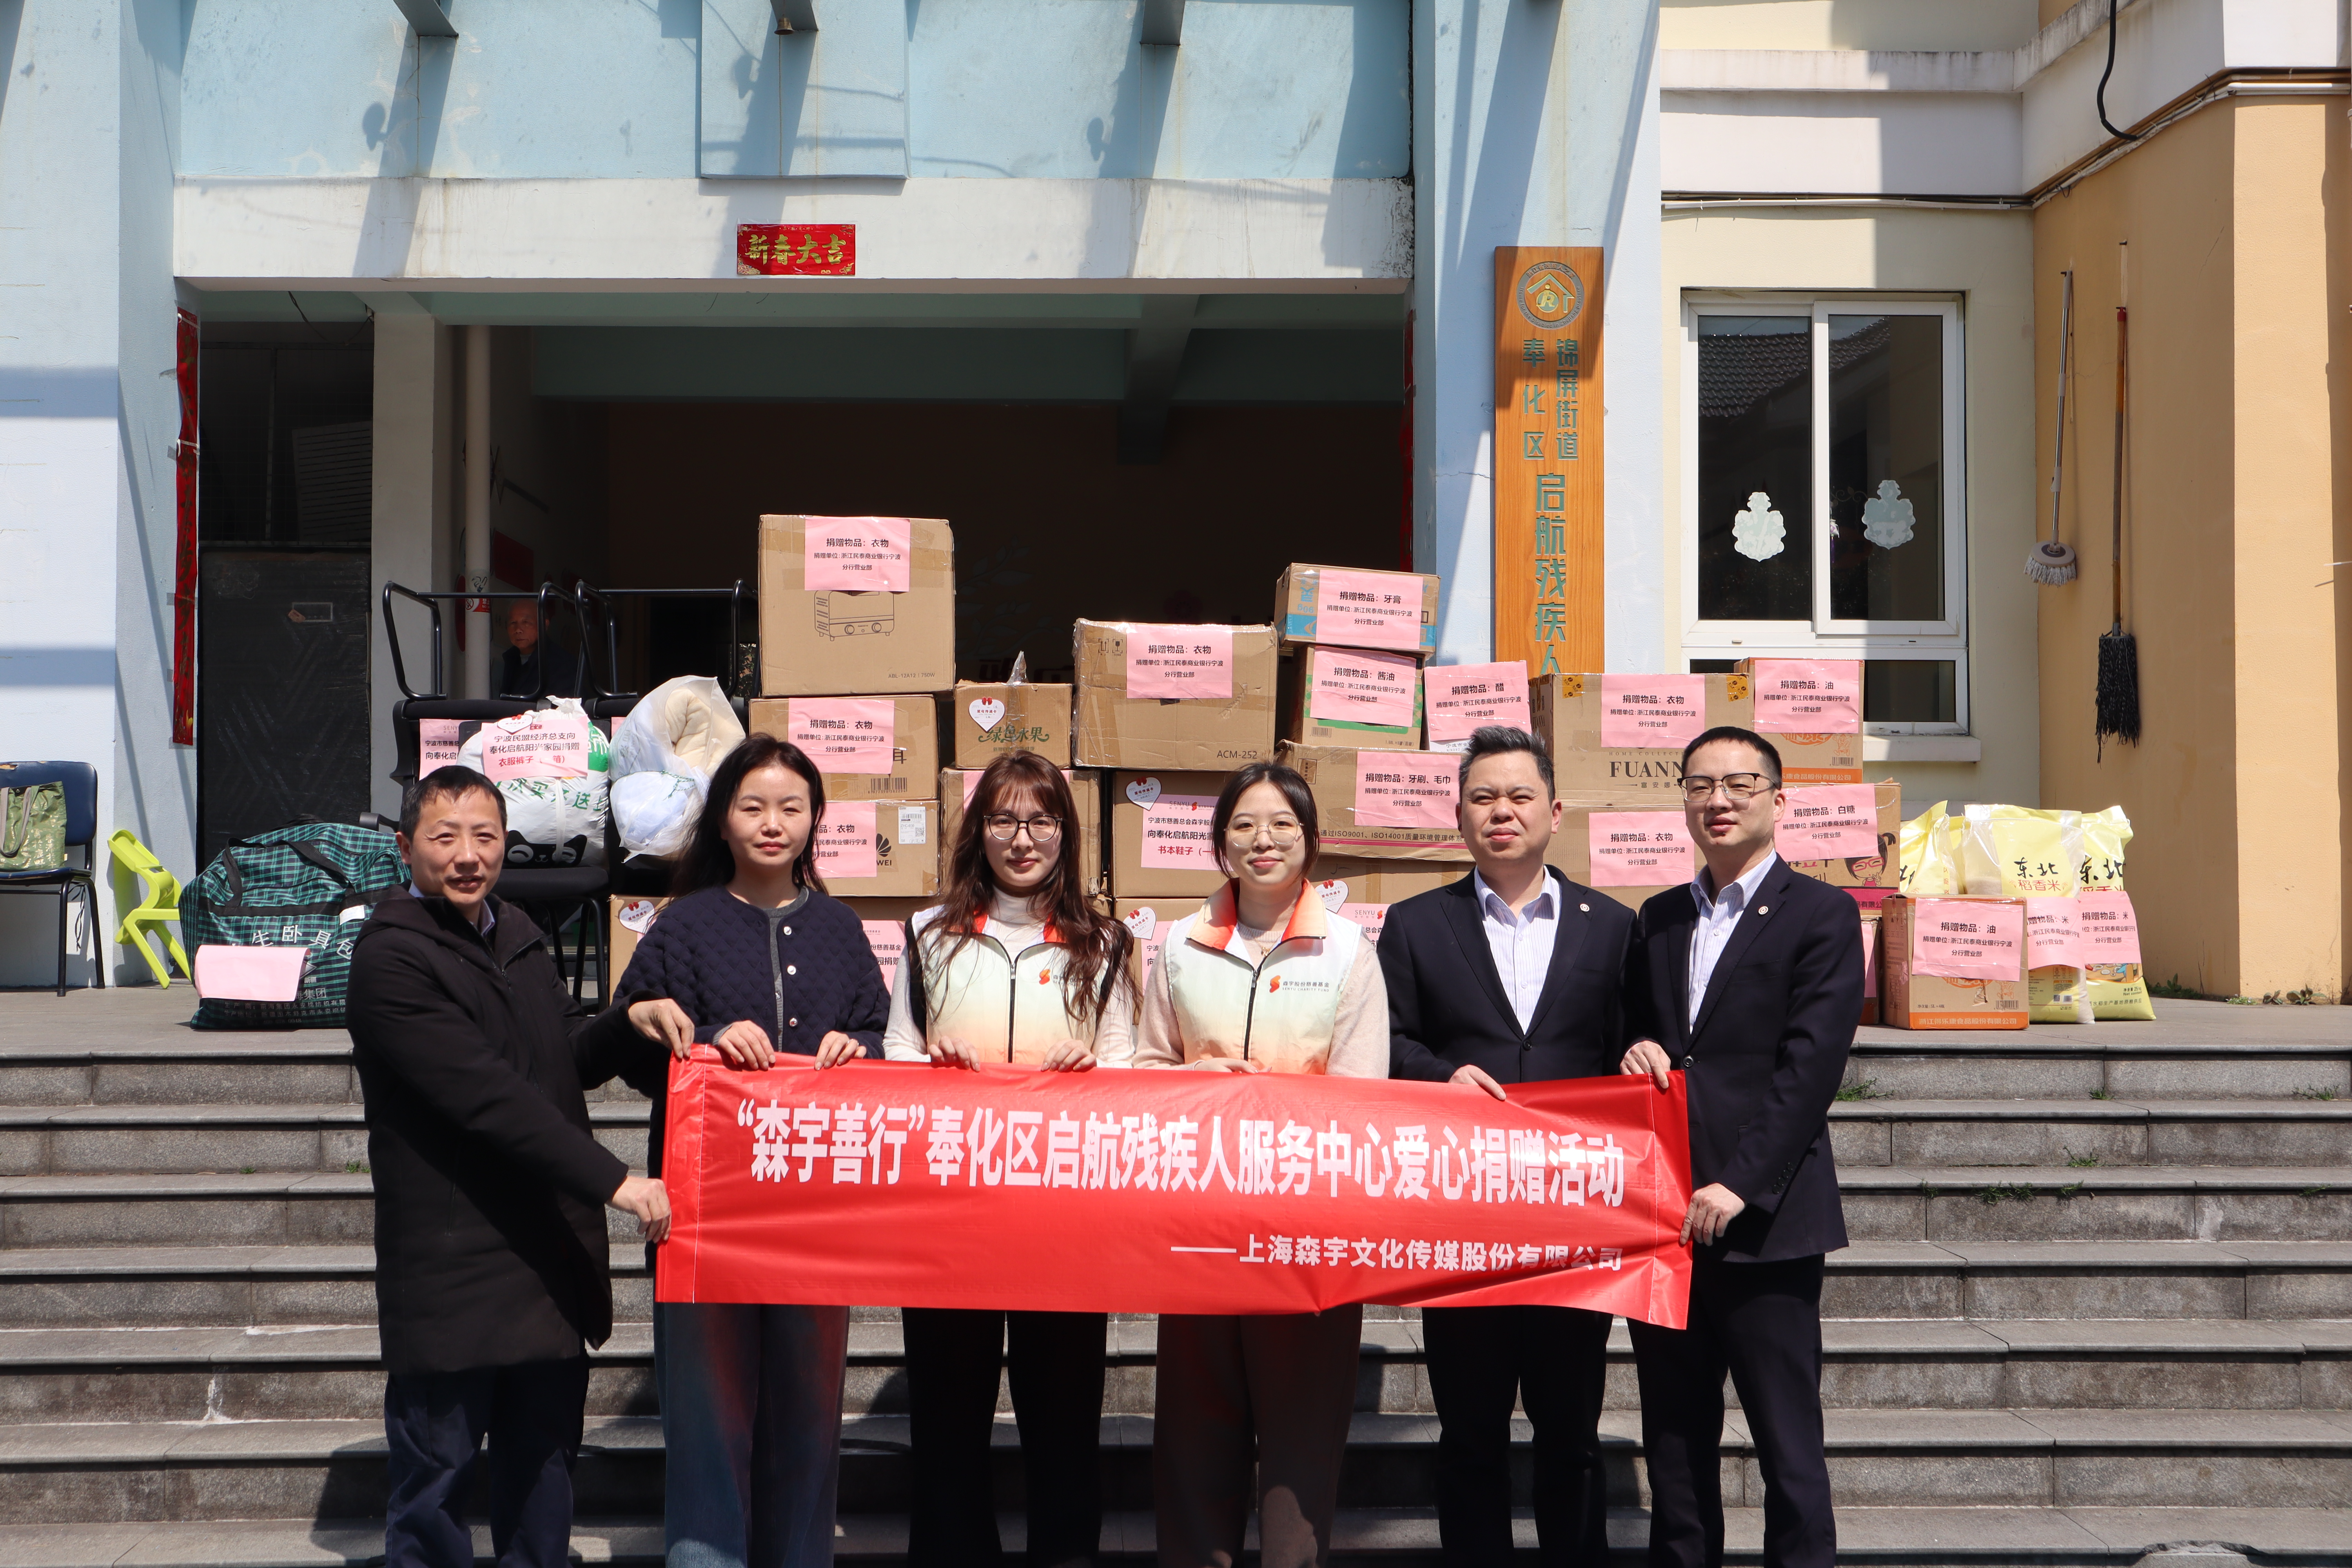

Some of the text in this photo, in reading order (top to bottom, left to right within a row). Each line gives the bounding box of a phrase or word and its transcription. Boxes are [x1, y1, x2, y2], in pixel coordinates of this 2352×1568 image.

[745, 233, 846, 265] 新春大吉
[1526, 262, 1576, 279] 浙江省残疾人之家
[1523, 338, 1545, 460] 奉化区
[1556, 338, 1578, 460] 锦屏街道
[826, 538, 889, 548] 捐赠物品：衣物
[814, 552, 901, 560] 捐赠单位:浙江民泰商业银行宁波
[1535, 473, 1566, 675] 启航残疾人
[1339, 591, 1401, 604] 捐赠物品：牙膏
[1327, 604, 1412, 617] 捐赠单位:浙江民泰商业银行宁波
[1148, 644, 1211, 654] 捐赠物品：衣物
[1334, 667, 1395, 681] 捐赠物品：酱油
[1321, 680, 1406, 695] 捐赠单位:浙江民泰商业银行宁波
[1452, 683, 1504, 695] 捐赠物品：醋
[1780, 680, 1834, 690] 捐赠物品：油
[1348, 694, 1377, 702] 分行营业部
[1436, 696, 1521, 708] 捐赠单位:浙江民泰商业银行宁波
[1622, 695, 1684, 704] 捐赠物品：衣物
[1610, 709, 1696, 717] 捐赠单位:浙江民泰商业银行宁波
[810, 719, 873, 730] 捐赠物品：衣物
[494, 732, 575, 743] 宁波民盟经济总支向
[797, 733, 884, 742] 捐赠单位:浙江民泰商业银行宁波
[978, 724, 1049, 743] 绿色水果
[489, 742, 580, 755] 奉化启航阳光家园捐赠
[425, 751, 459, 760] 向奉化启
[1216, 750, 1258, 759] ACM-252
[498, 755, 565, 767] 衣服裤子（箱）
[1365, 773, 1451, 784] 捐赠物品：牙刷、毛巾
[1365, 788, 1450, 797] 捐赠单位:浙江民泰商业银行宁波
[1794, 806, 1855, 817] 捐赠物品：白糖
[1148, 817, 1212, 826] 宁波市慈善总会森宇股
[1782, 819, 1869, 830] 捐赠单位:浙江民泰商业银行宁波
[817, 824, 855, 834] 品：衣物
[1320, 829, 1466, 842] 通过ISO9001、ISO14001质量环境管理体系
[1611, 833, 1673, 842] 捐赠物品：衣物
[2014, 857, 2059, 879] 东北
[2018, 879, 2061, 891] 稻香米
[2027, 915, 2069, 925] 赠物品：米
[2082, 911, 2128, 920] 捐赠物品：米
[1940, 922, 1996, 934] 捐赠物品：油
[2027, 928, 2080, 938] :浙江民泰商业银行宁波
[232, 924, 354, 960] 生卧具包
[1922, 935, 2012, 947] 捐赠单位:浙江民泰商业银行宁波
[737, 1098, 1624, 1207] “森宇善行”奉化区启航残疾人服务中心爱心捐赠活动
[1171, 1234, 1623, 1272] ——上海森宇文化传媒股份有限公司
